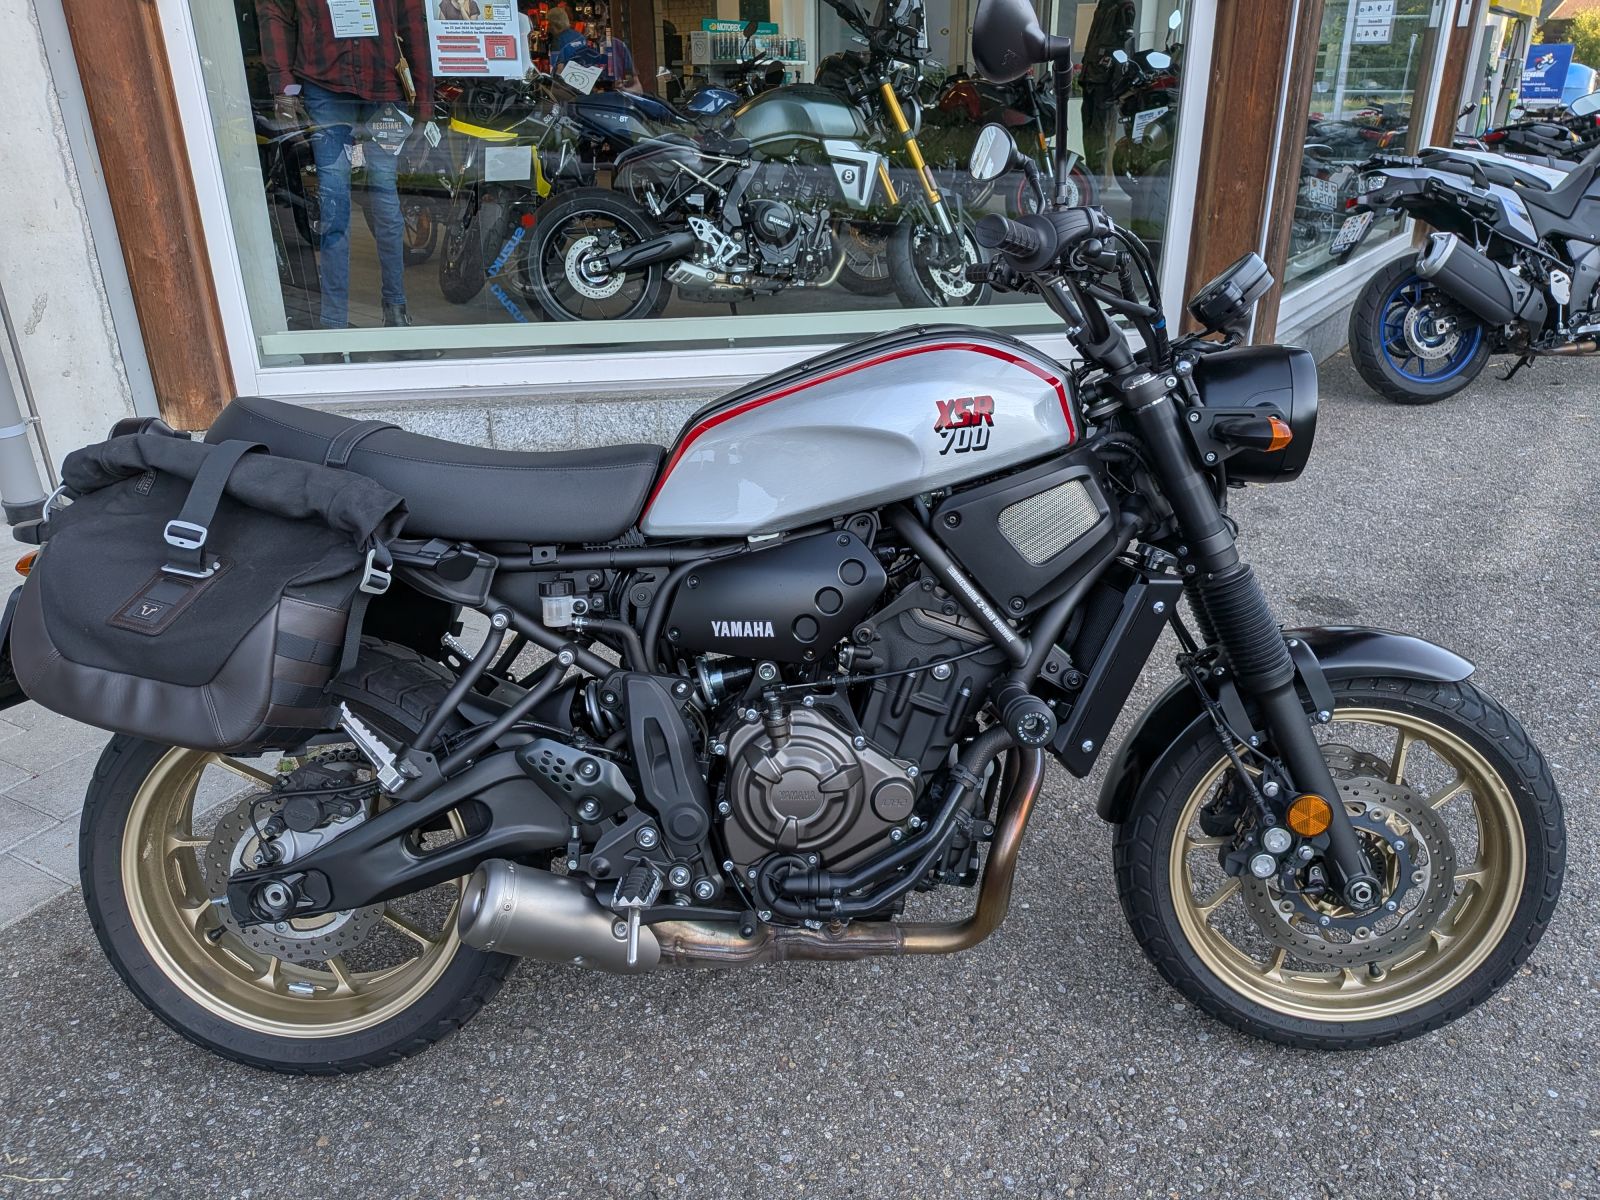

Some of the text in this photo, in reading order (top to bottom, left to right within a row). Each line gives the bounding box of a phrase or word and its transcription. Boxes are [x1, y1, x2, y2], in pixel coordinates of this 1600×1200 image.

[716, 22, 741, 32] MOTOREX
[372, 121, 402, 130] RESISTANT
[1504, 152, 1527, 161] SUZUKI
[844, 170, 853, 180] 8
[768, 215, 791, 228] SUZUKI
[934, 395, 995, 433] XSR
[939, 426, 991, 456] 700
[711, 620, 775, 638] YAMAHA
[778, 790, 817, 800] YAMAHA
